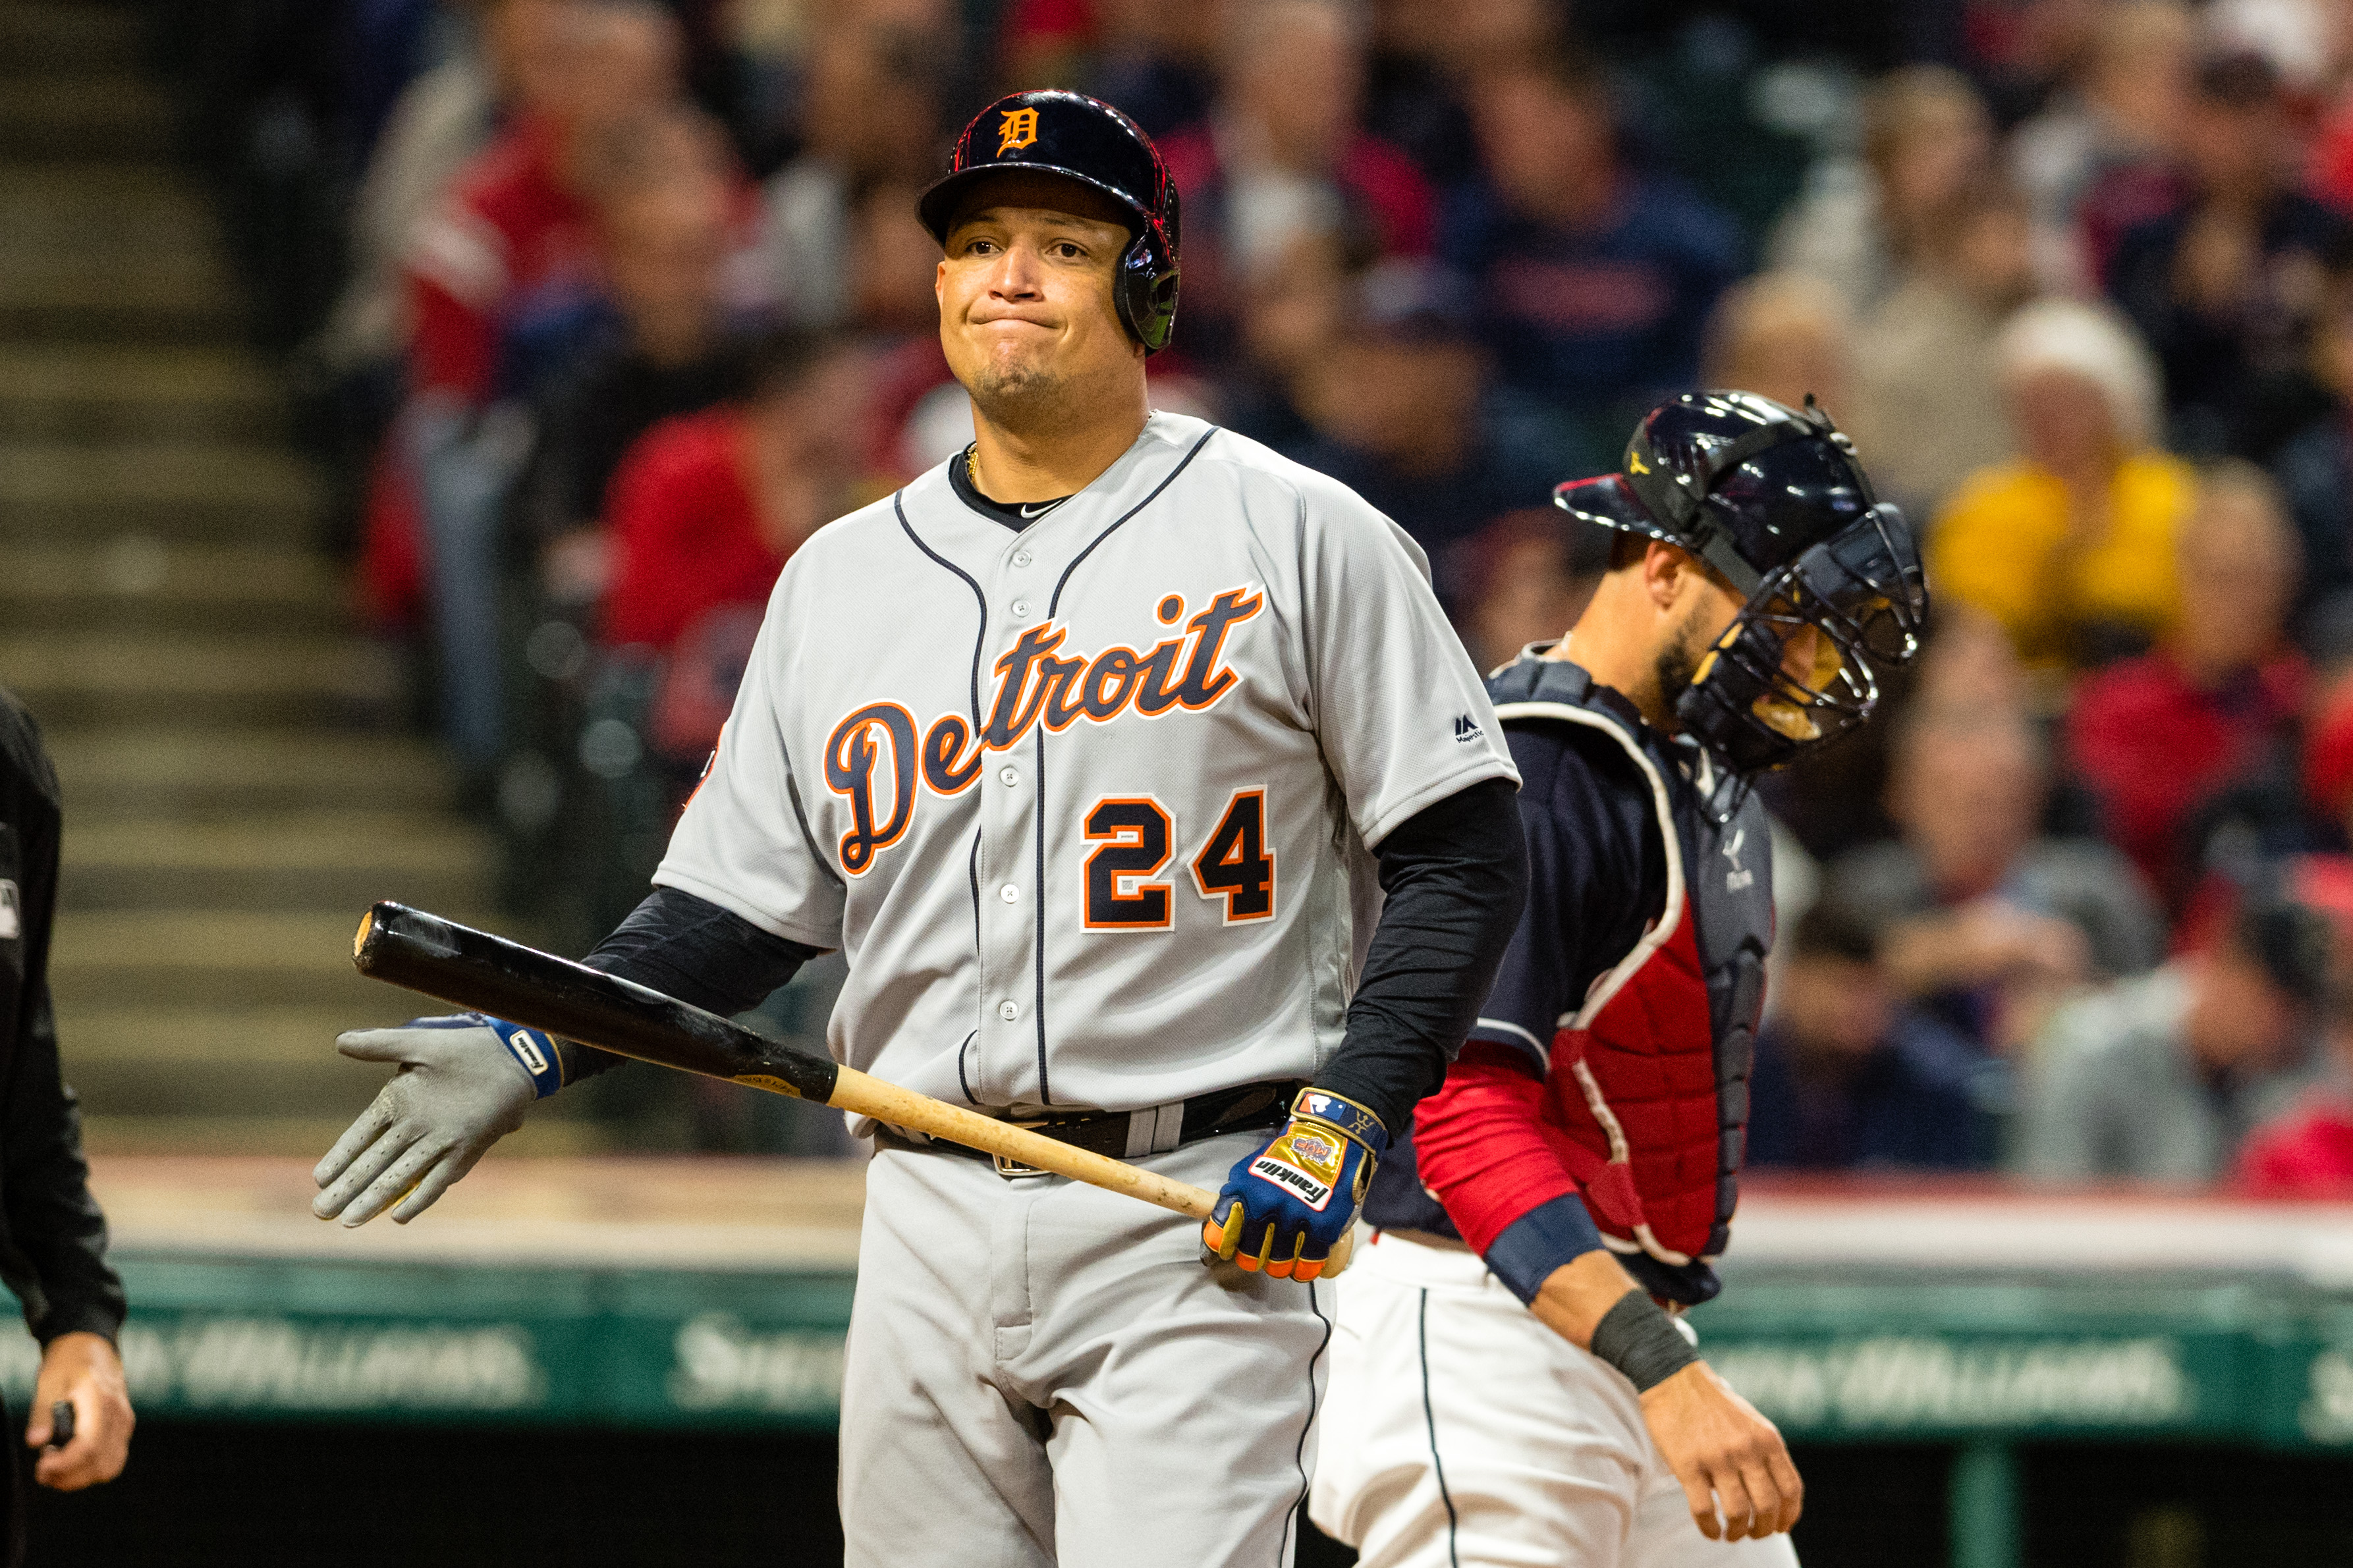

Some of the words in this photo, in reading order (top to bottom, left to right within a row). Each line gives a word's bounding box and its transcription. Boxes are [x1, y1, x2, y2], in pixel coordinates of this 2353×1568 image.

[997, 107, 1039, 157] D
[823, 581, 1266, 878] Detroit
[1080, 784, 1276, 934] 24
